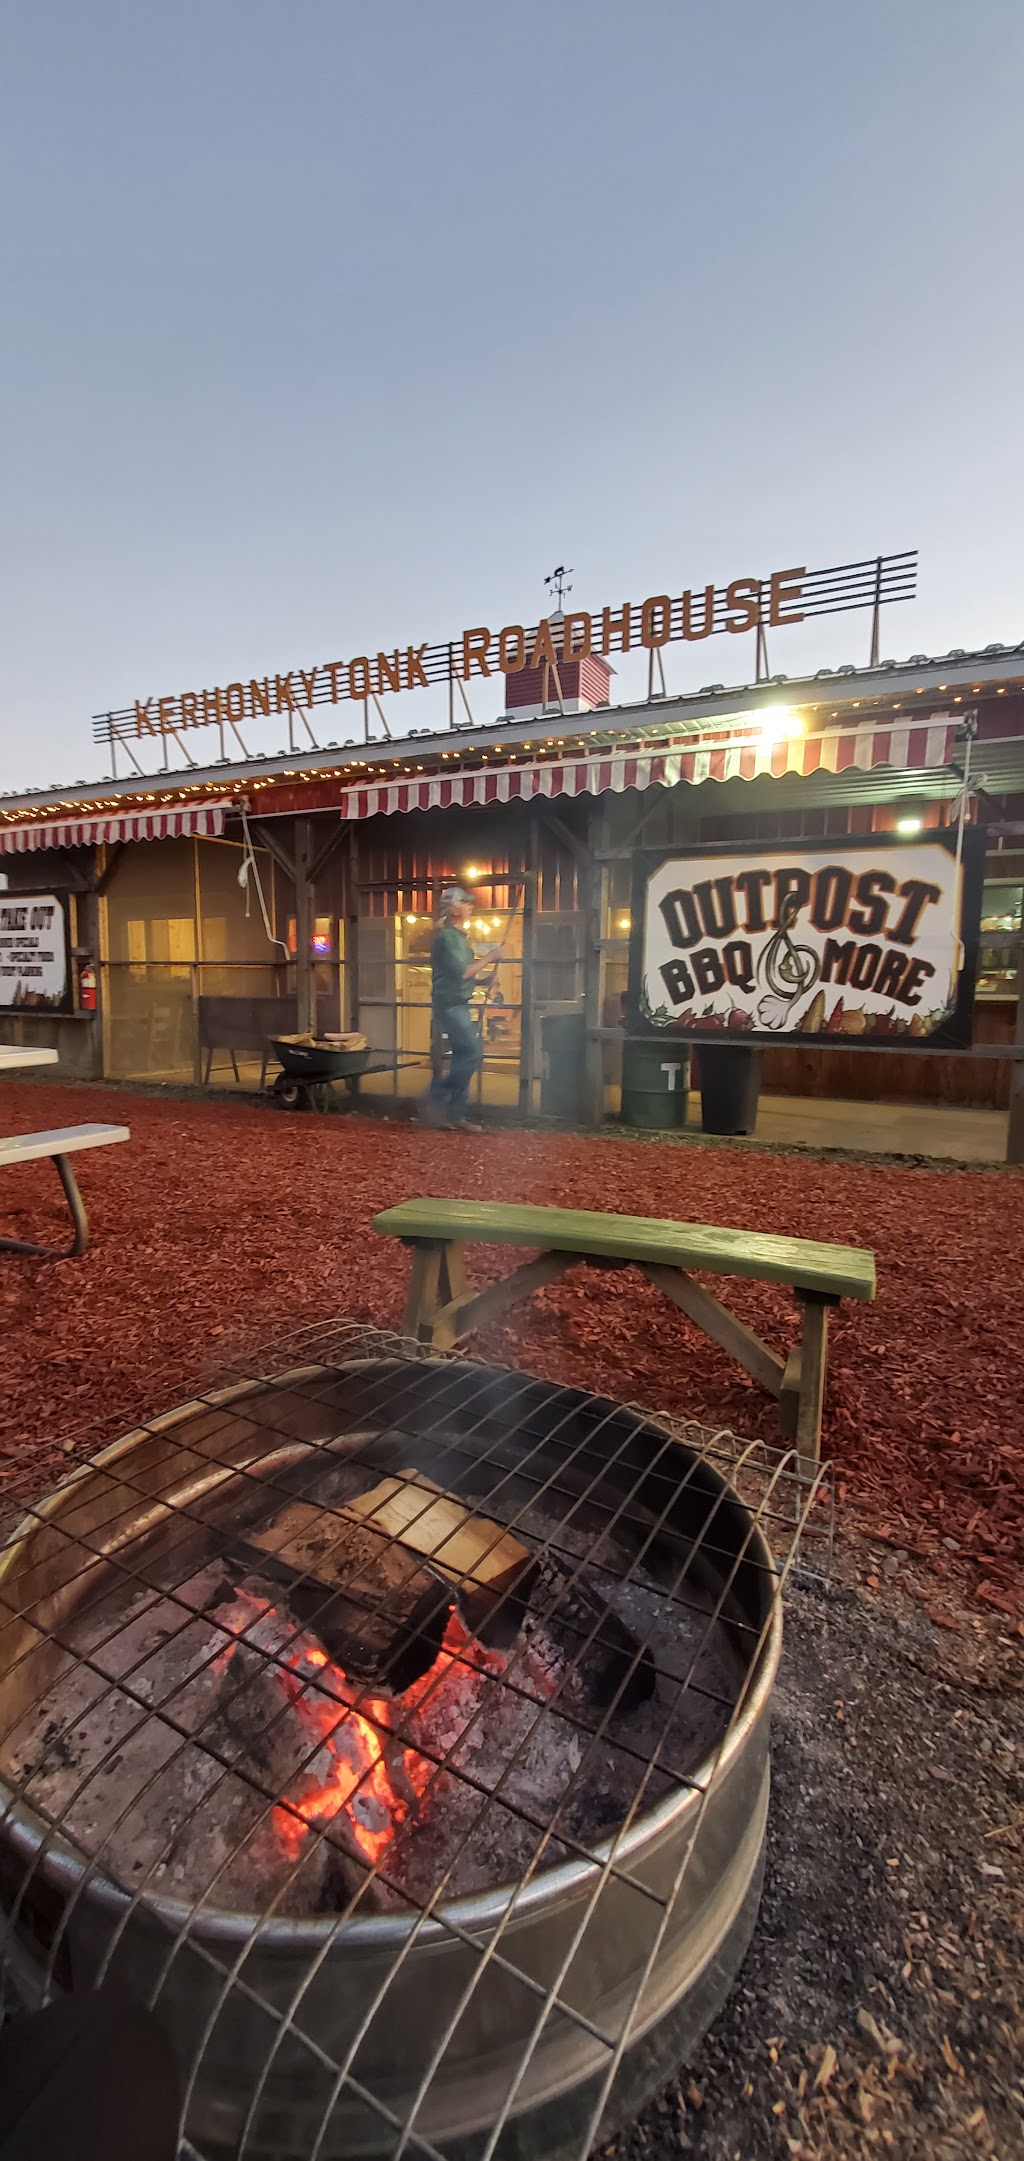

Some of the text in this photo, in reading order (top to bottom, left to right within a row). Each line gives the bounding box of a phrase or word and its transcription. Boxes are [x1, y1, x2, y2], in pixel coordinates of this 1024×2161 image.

[134, 567, 806, 739] KERHONKYTONK ROADHOUSE
[659, 865, 941, 948] OUTPOST
[659, 938, 936, 1006] BBQ MORE
